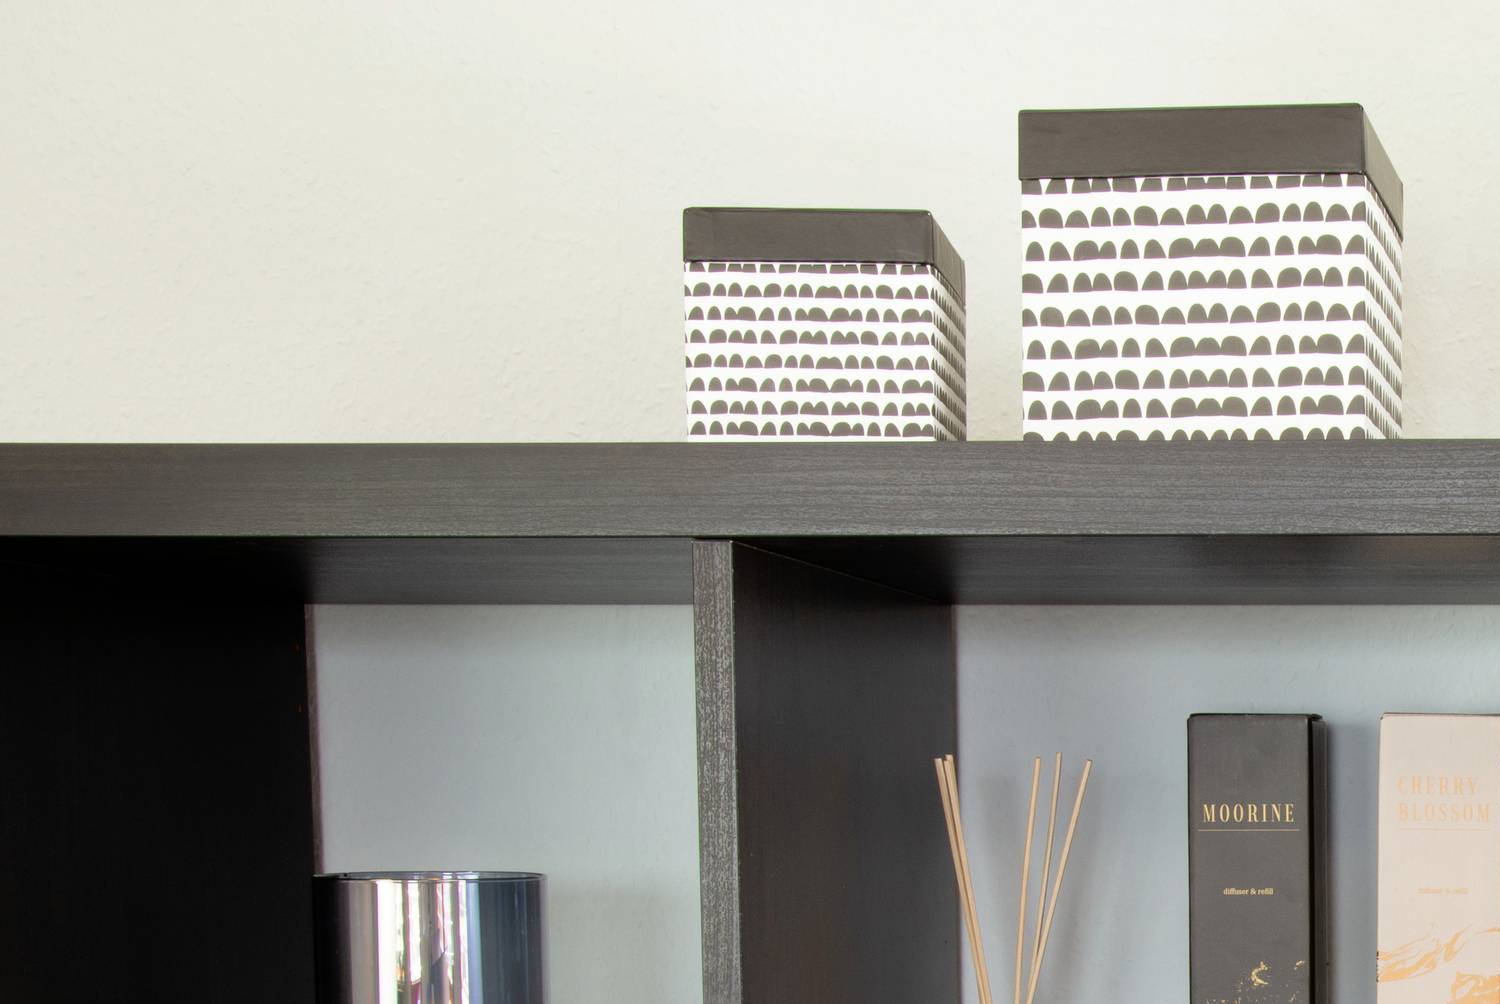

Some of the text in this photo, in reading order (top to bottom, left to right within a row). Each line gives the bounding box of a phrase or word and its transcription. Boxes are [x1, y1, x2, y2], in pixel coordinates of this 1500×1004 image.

[1396, 775, 1479, 796] CHERRY
[1203, 803, 1295, 823] MOORINE
[1398, 803, 1490, 823] BLOSSOM
